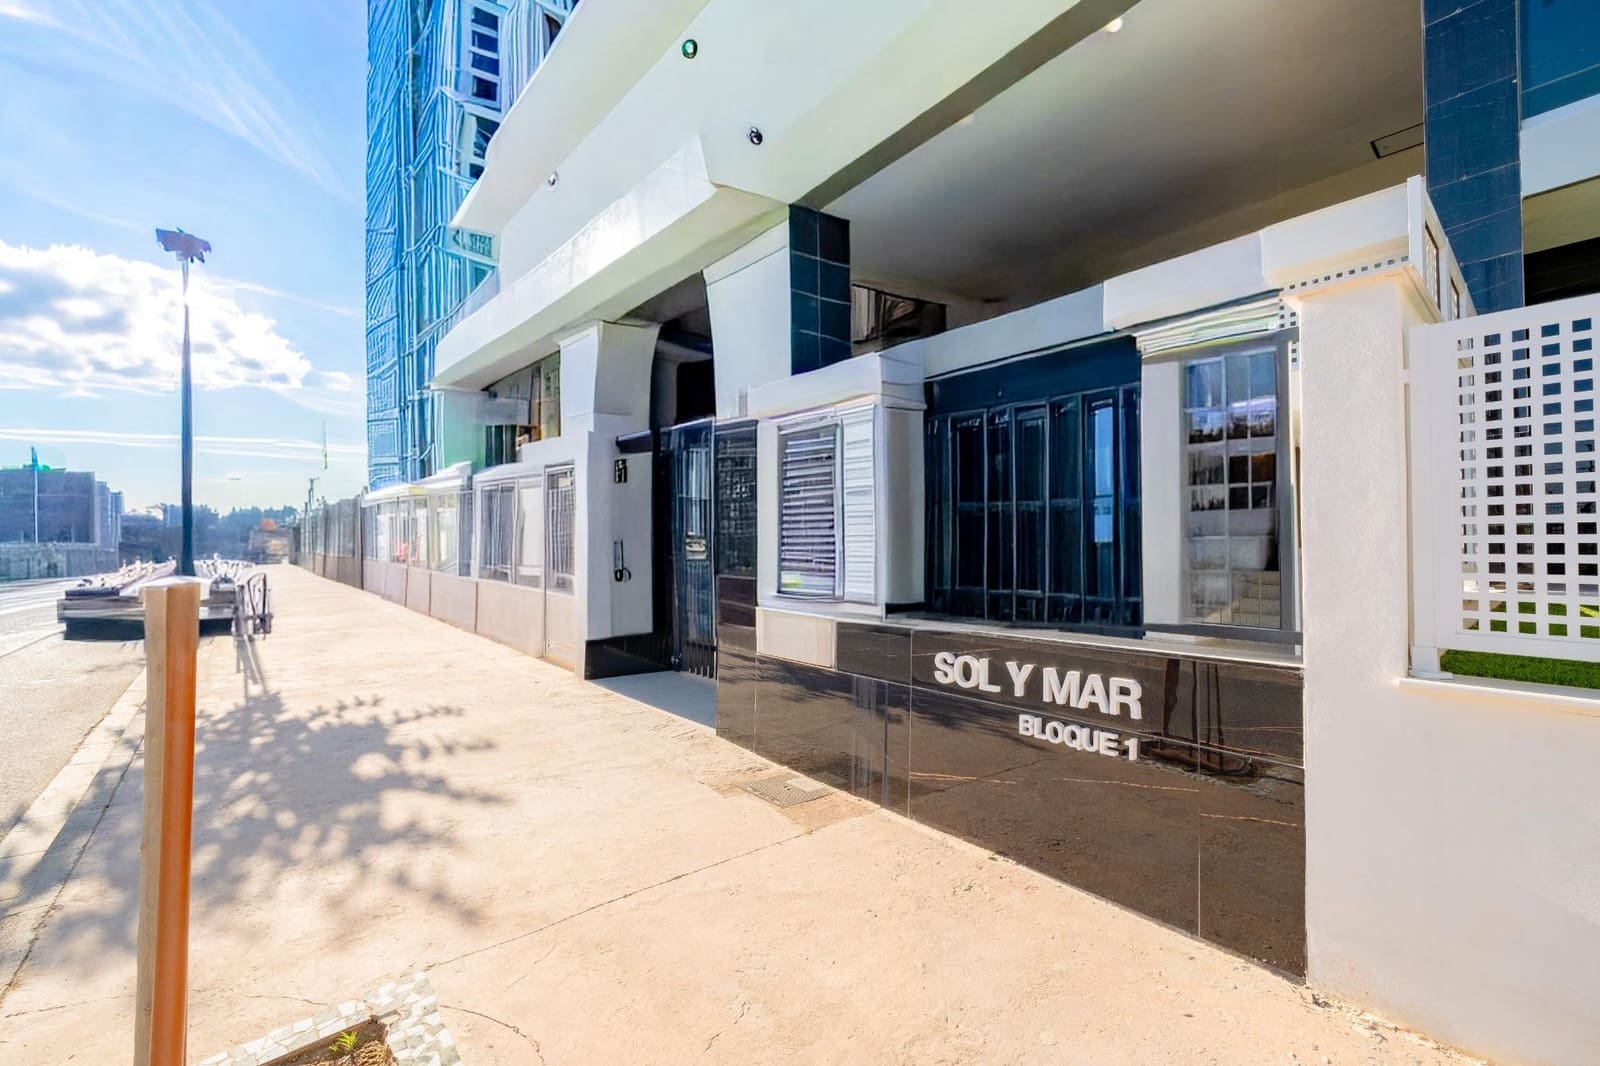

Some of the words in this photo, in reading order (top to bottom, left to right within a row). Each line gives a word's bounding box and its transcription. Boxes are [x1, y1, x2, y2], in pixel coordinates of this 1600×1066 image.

[934, 652, 1001, 693] SOL
[1005, 661, 1035, 697] Y
[1042, 667, 1143, 720] MAR
[1018, 714, 1119, 757] BLOQUE
[1124, 737, 1139, 761] 1
